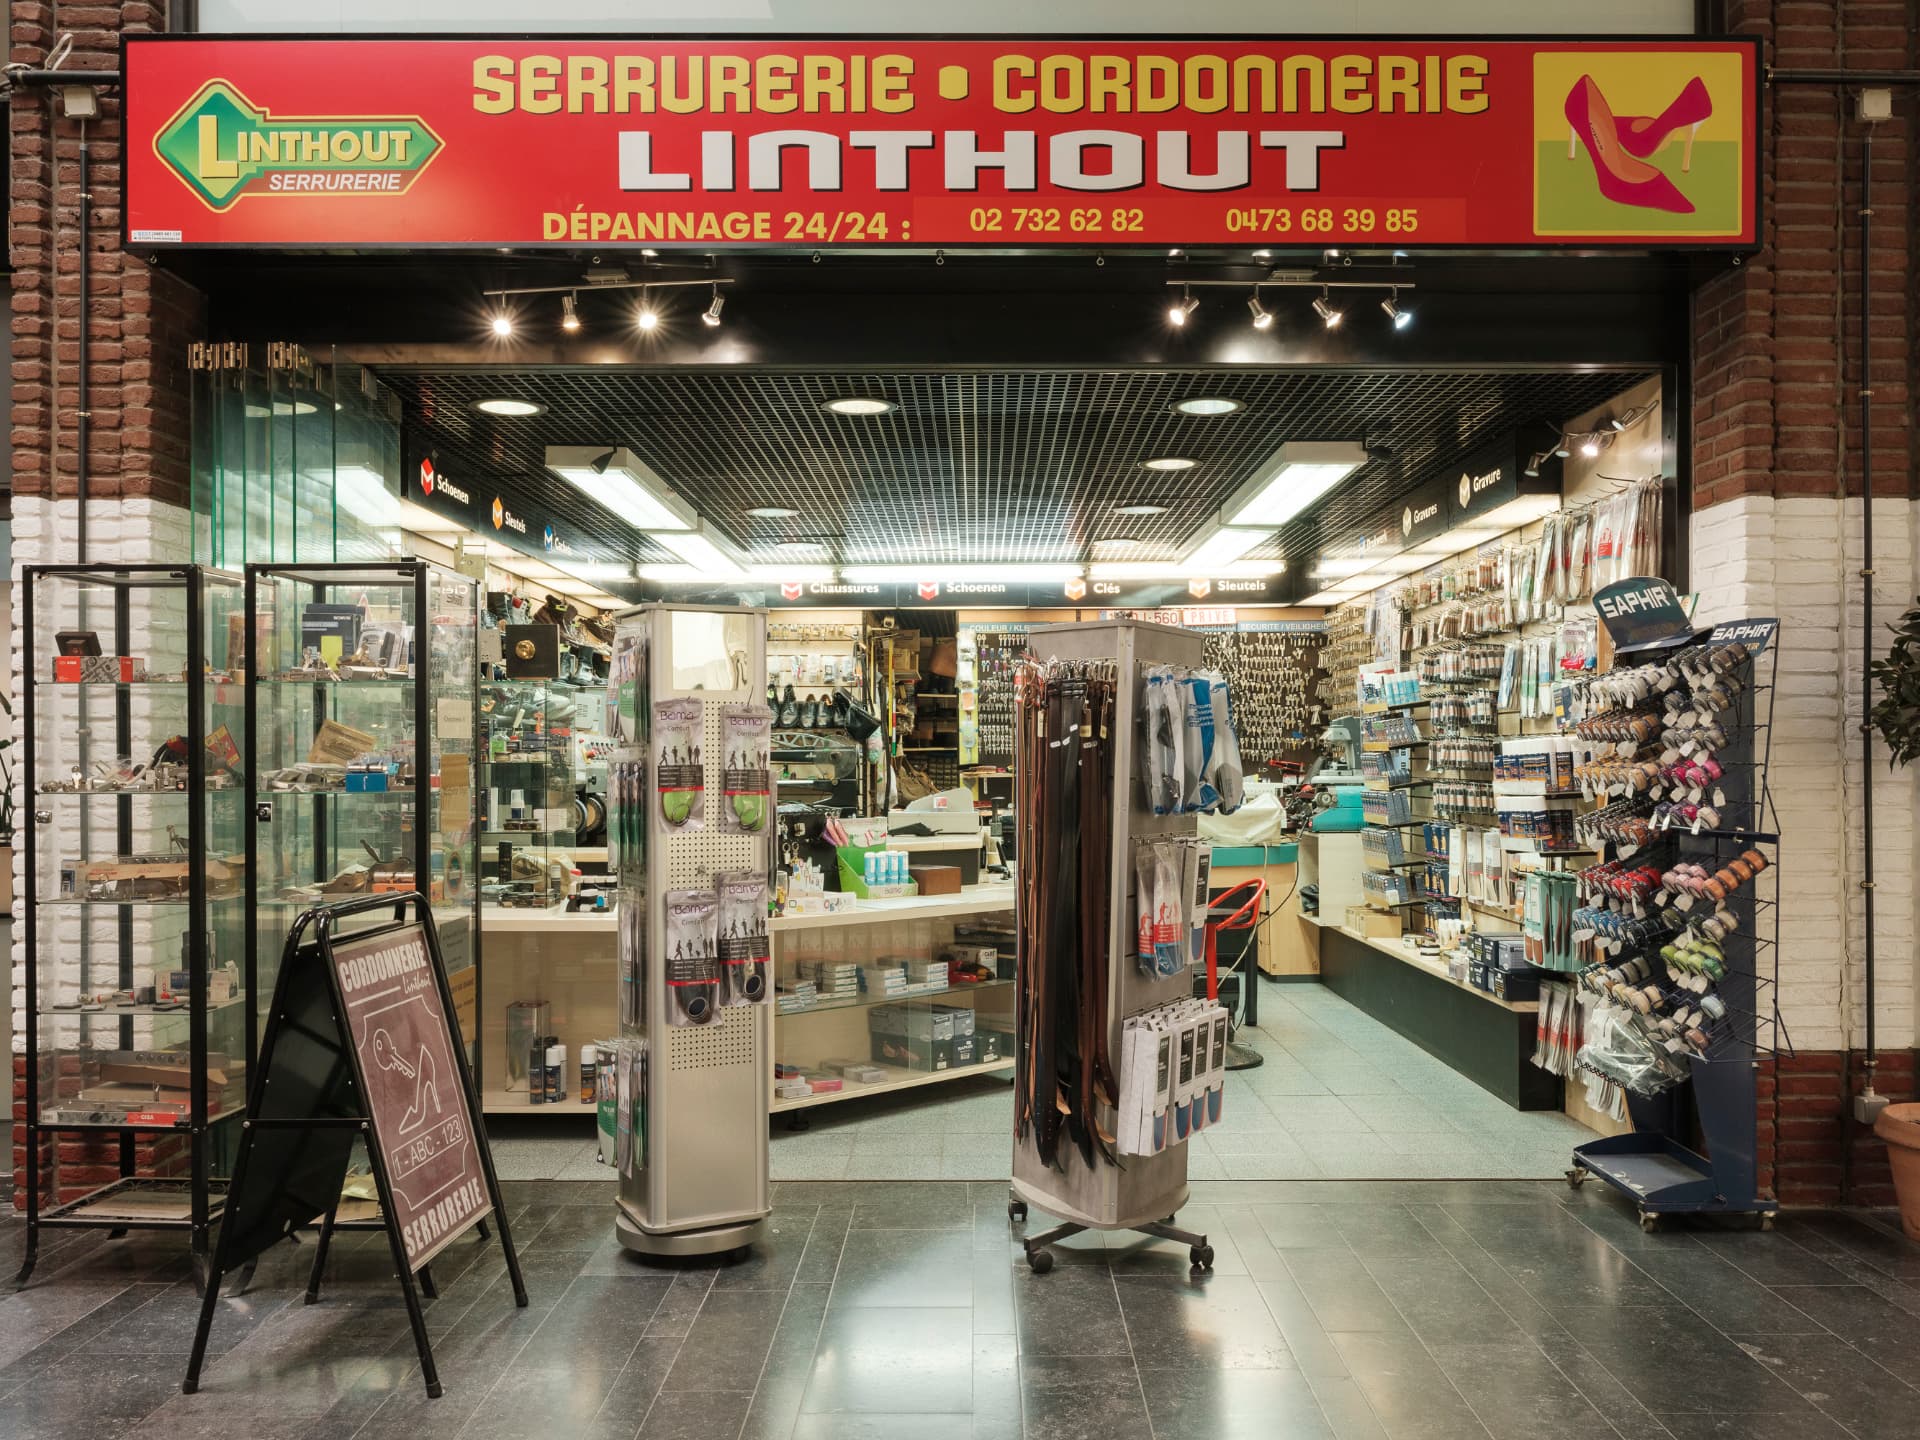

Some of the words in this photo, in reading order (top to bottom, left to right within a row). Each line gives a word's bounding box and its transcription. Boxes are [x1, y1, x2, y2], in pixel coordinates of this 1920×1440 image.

[473, 54, 914, 115] SERRURERIE
[993, 54, 1490, 114] CORDONNERIE
[199, 115, 412, 178] LINTHOUT
[618, 129, 1344, 191] LINTHOUT
[269, 173, 401, 190] SERRURERIE
[543, 203, 771, 240] DÉPANNAGE
[783, 211, 889, 242] 24/24
[970, 208, 1002, 231] 02
[1012, 208, 1060, 231] 732
[1069, 208, 1102, 231] 62
[1111, 208, 1144, 231] 82
[1226, 208, 1292, 231] 0473
[1301, 208, 1334, 231] 68
[1343, 208, 1376, 231] 39
[1385, 208, 1418, 231] 85
[437, 474, 469, 504] Schoenen
[1473, 468, 1501, 492] Gravure
[505, 512, 526, 534] Sleutels
[1414, 503, 1438, 524] Gravures
[810, 583, 879, 594] Chaussures
[946, 582, 1006, 593] Schoenen
[1093, 582, 1121, 594] Clés
[1217, 580, 1267, 592] Sleutels
[1600, 585, 1671, 619] SAPHIR
[1710, 622, 1772, 641] SAPHIR
[339, 940, 428, 993] CORDONNERIE
[411, 1135, 434, 1166] ABC
[442, 1120, 461, 1145] 123
[404, 1177, 482, 1258] SERRURERIE
